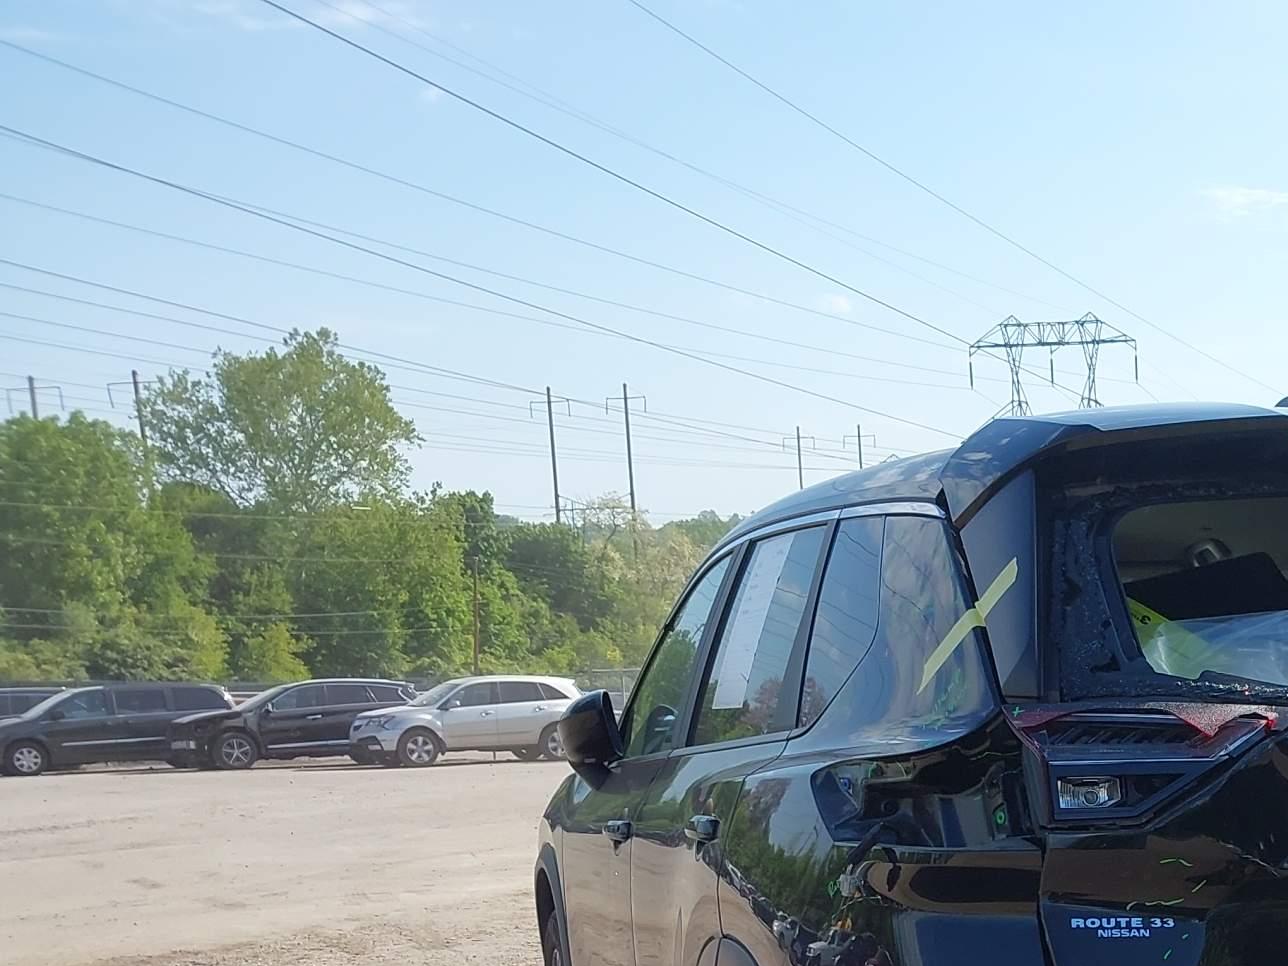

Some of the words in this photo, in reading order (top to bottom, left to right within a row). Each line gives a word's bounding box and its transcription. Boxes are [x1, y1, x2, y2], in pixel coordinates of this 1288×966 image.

[1071, 917, 1143, 928] ROUTE
[1149, 917, 1175, 928] 33
[1097, 928, 1150, 938] NISSAN
